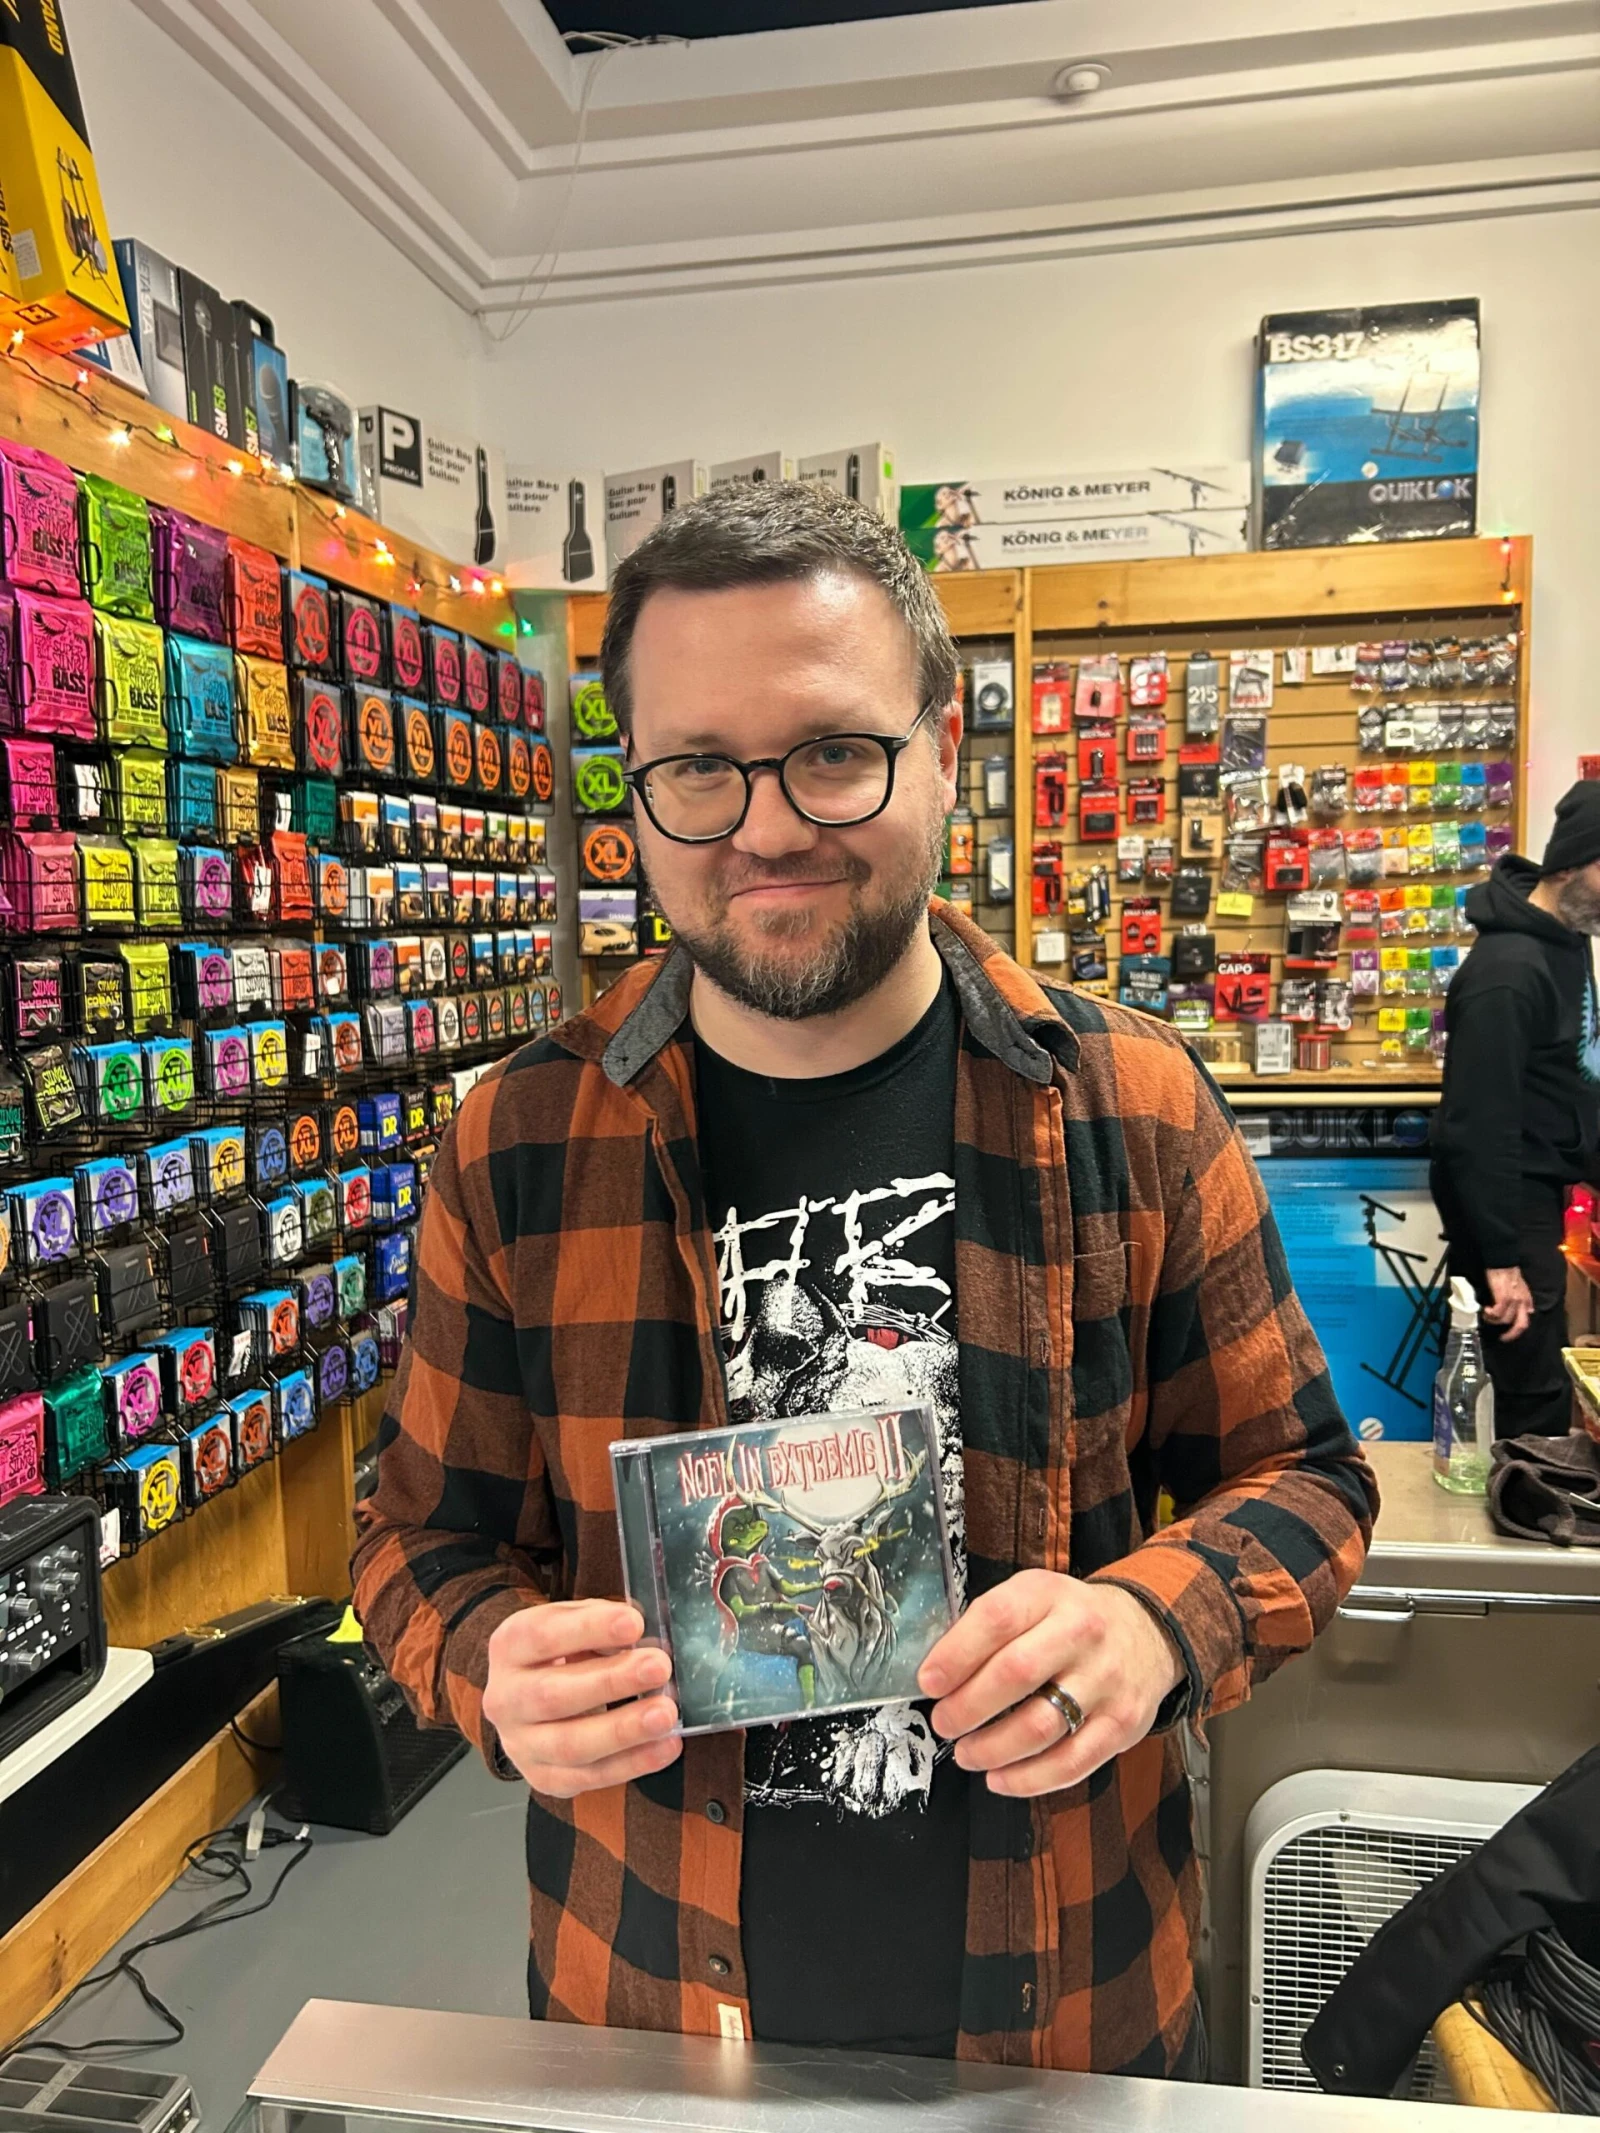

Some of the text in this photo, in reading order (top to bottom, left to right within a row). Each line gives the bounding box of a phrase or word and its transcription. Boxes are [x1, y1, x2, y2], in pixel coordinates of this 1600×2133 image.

[383, 411, 415, 461] P
[1003, 480, 1151, 501] KÖNIG & MEYER
[1002, 526, 1148, 546] KÖNIG & MEYER
[53, 666, 86, 694] BASS
[130, 686, 158, 711] BASS
[1188, 685, 1218, 704] 215
[584, 698, 614, 721] XL
[587, 772, 617, 793] XL
[594, 840, 625, 864] XL
[654, 916, 672, 942] D
[1218, 963, 1252, 975] CAPO
[87, 993, 121, 1007] COBALT
[382, 1115, 398, 1138] DR
[410, 1106, 425, 1129] DR
[398, 1188, 412, 1210] DR
[41, 1210, 69, 1241] XL
[678, 1413, 909, 1507] NOËL IN EXTREMIS II
[149, 1480, 176, 1512] XL
